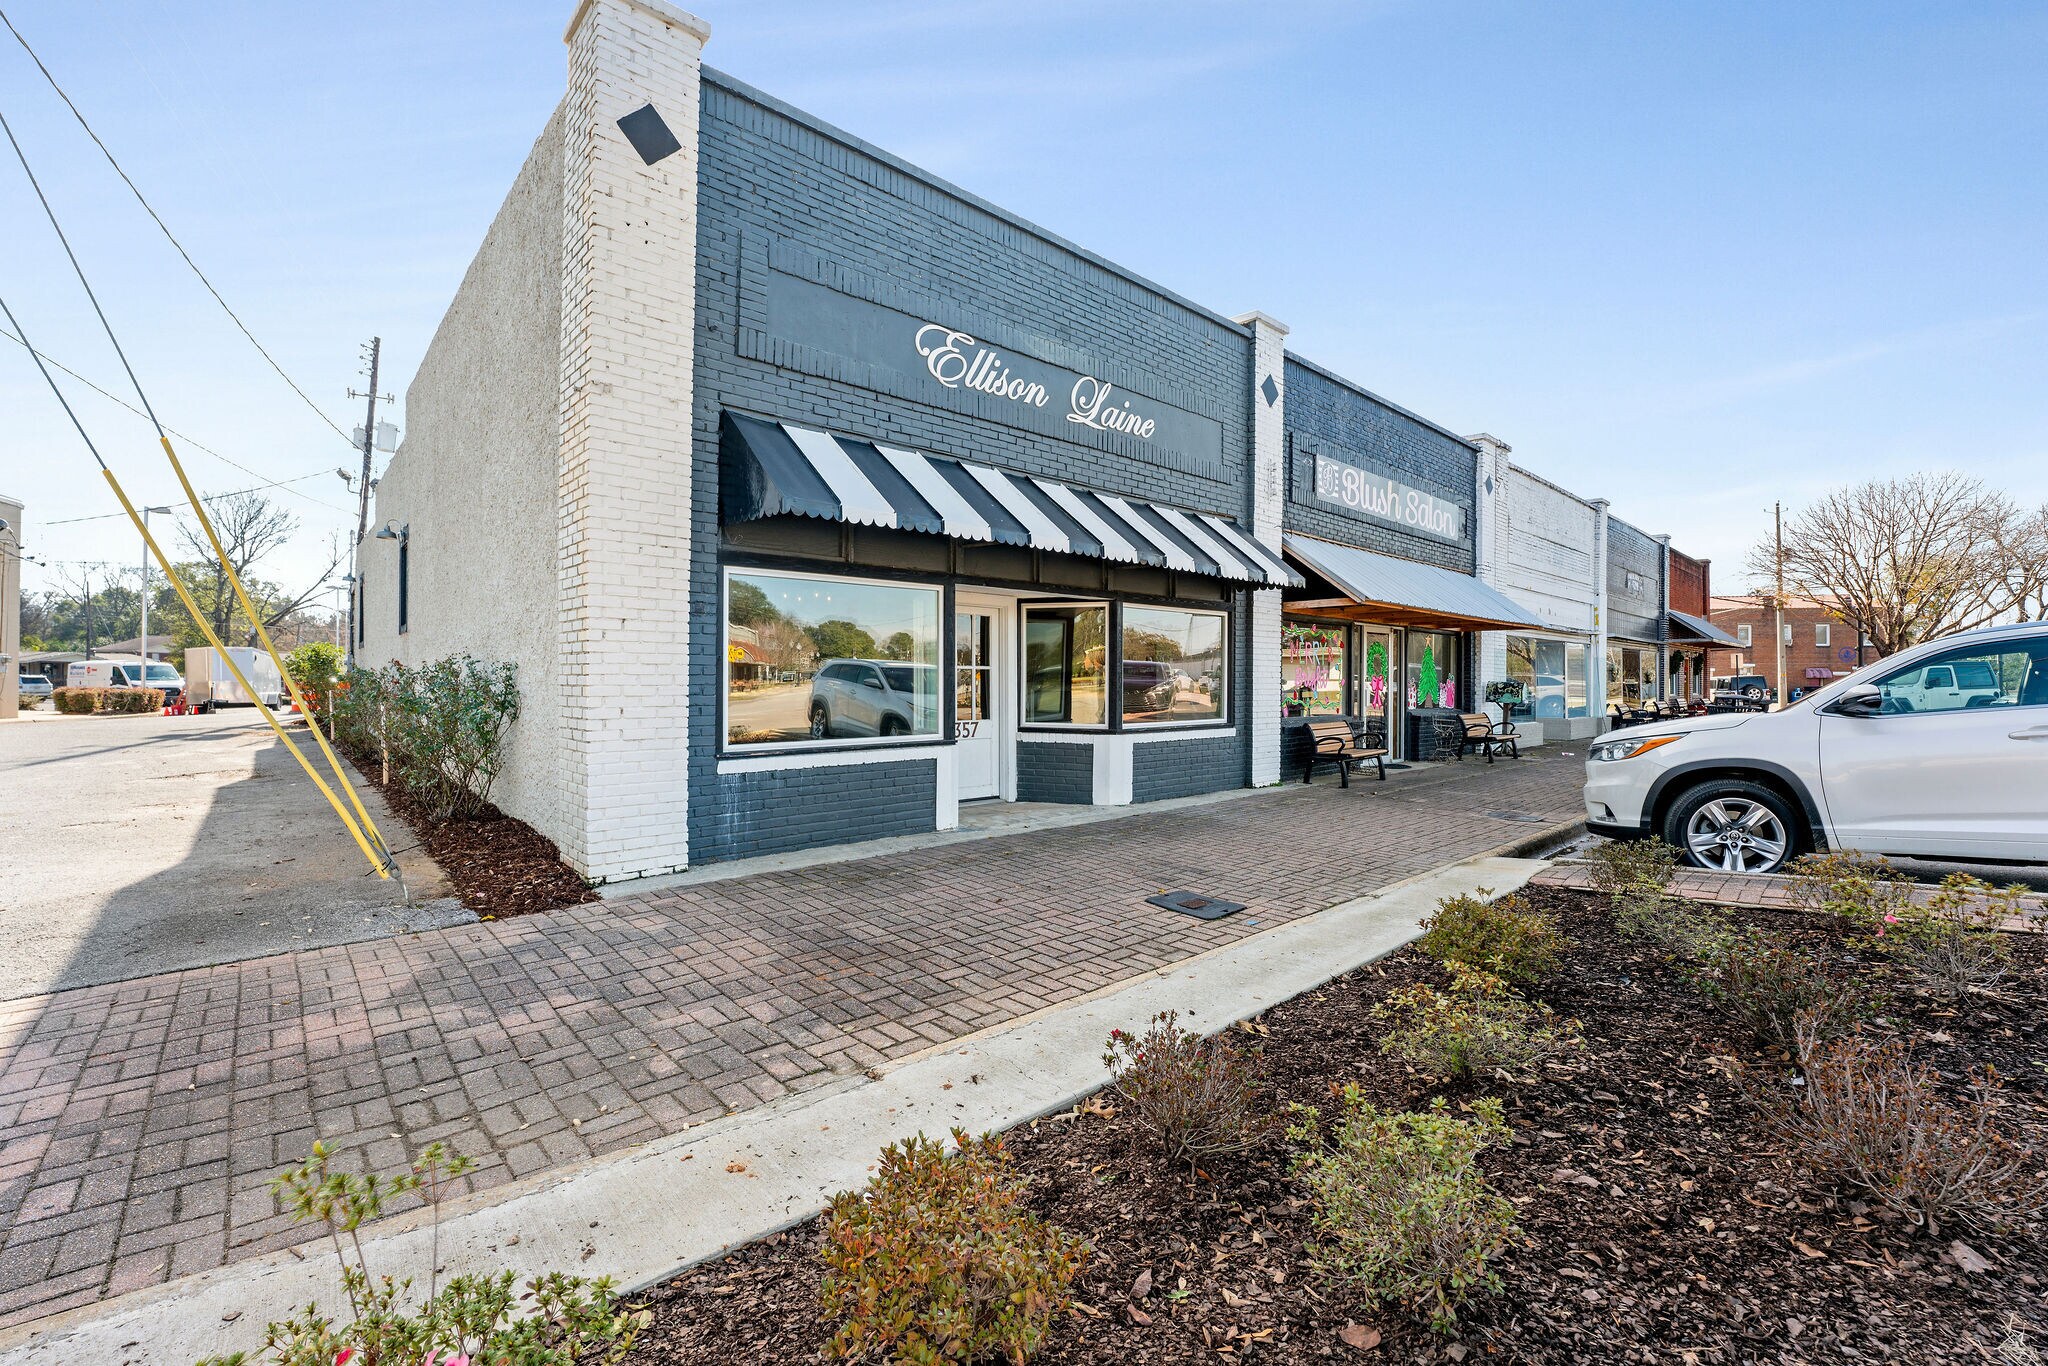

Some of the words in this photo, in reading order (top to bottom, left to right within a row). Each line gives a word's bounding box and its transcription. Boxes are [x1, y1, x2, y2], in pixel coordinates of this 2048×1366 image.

[915, 324, 1049, 408] Ellison
[1066, 376, 1155, 438] Laine
[1341, 468, 1402, 519] Blush
[1405, 491, 1456, 537] Salon
[1289, 639, 1327, 665] MERRY
